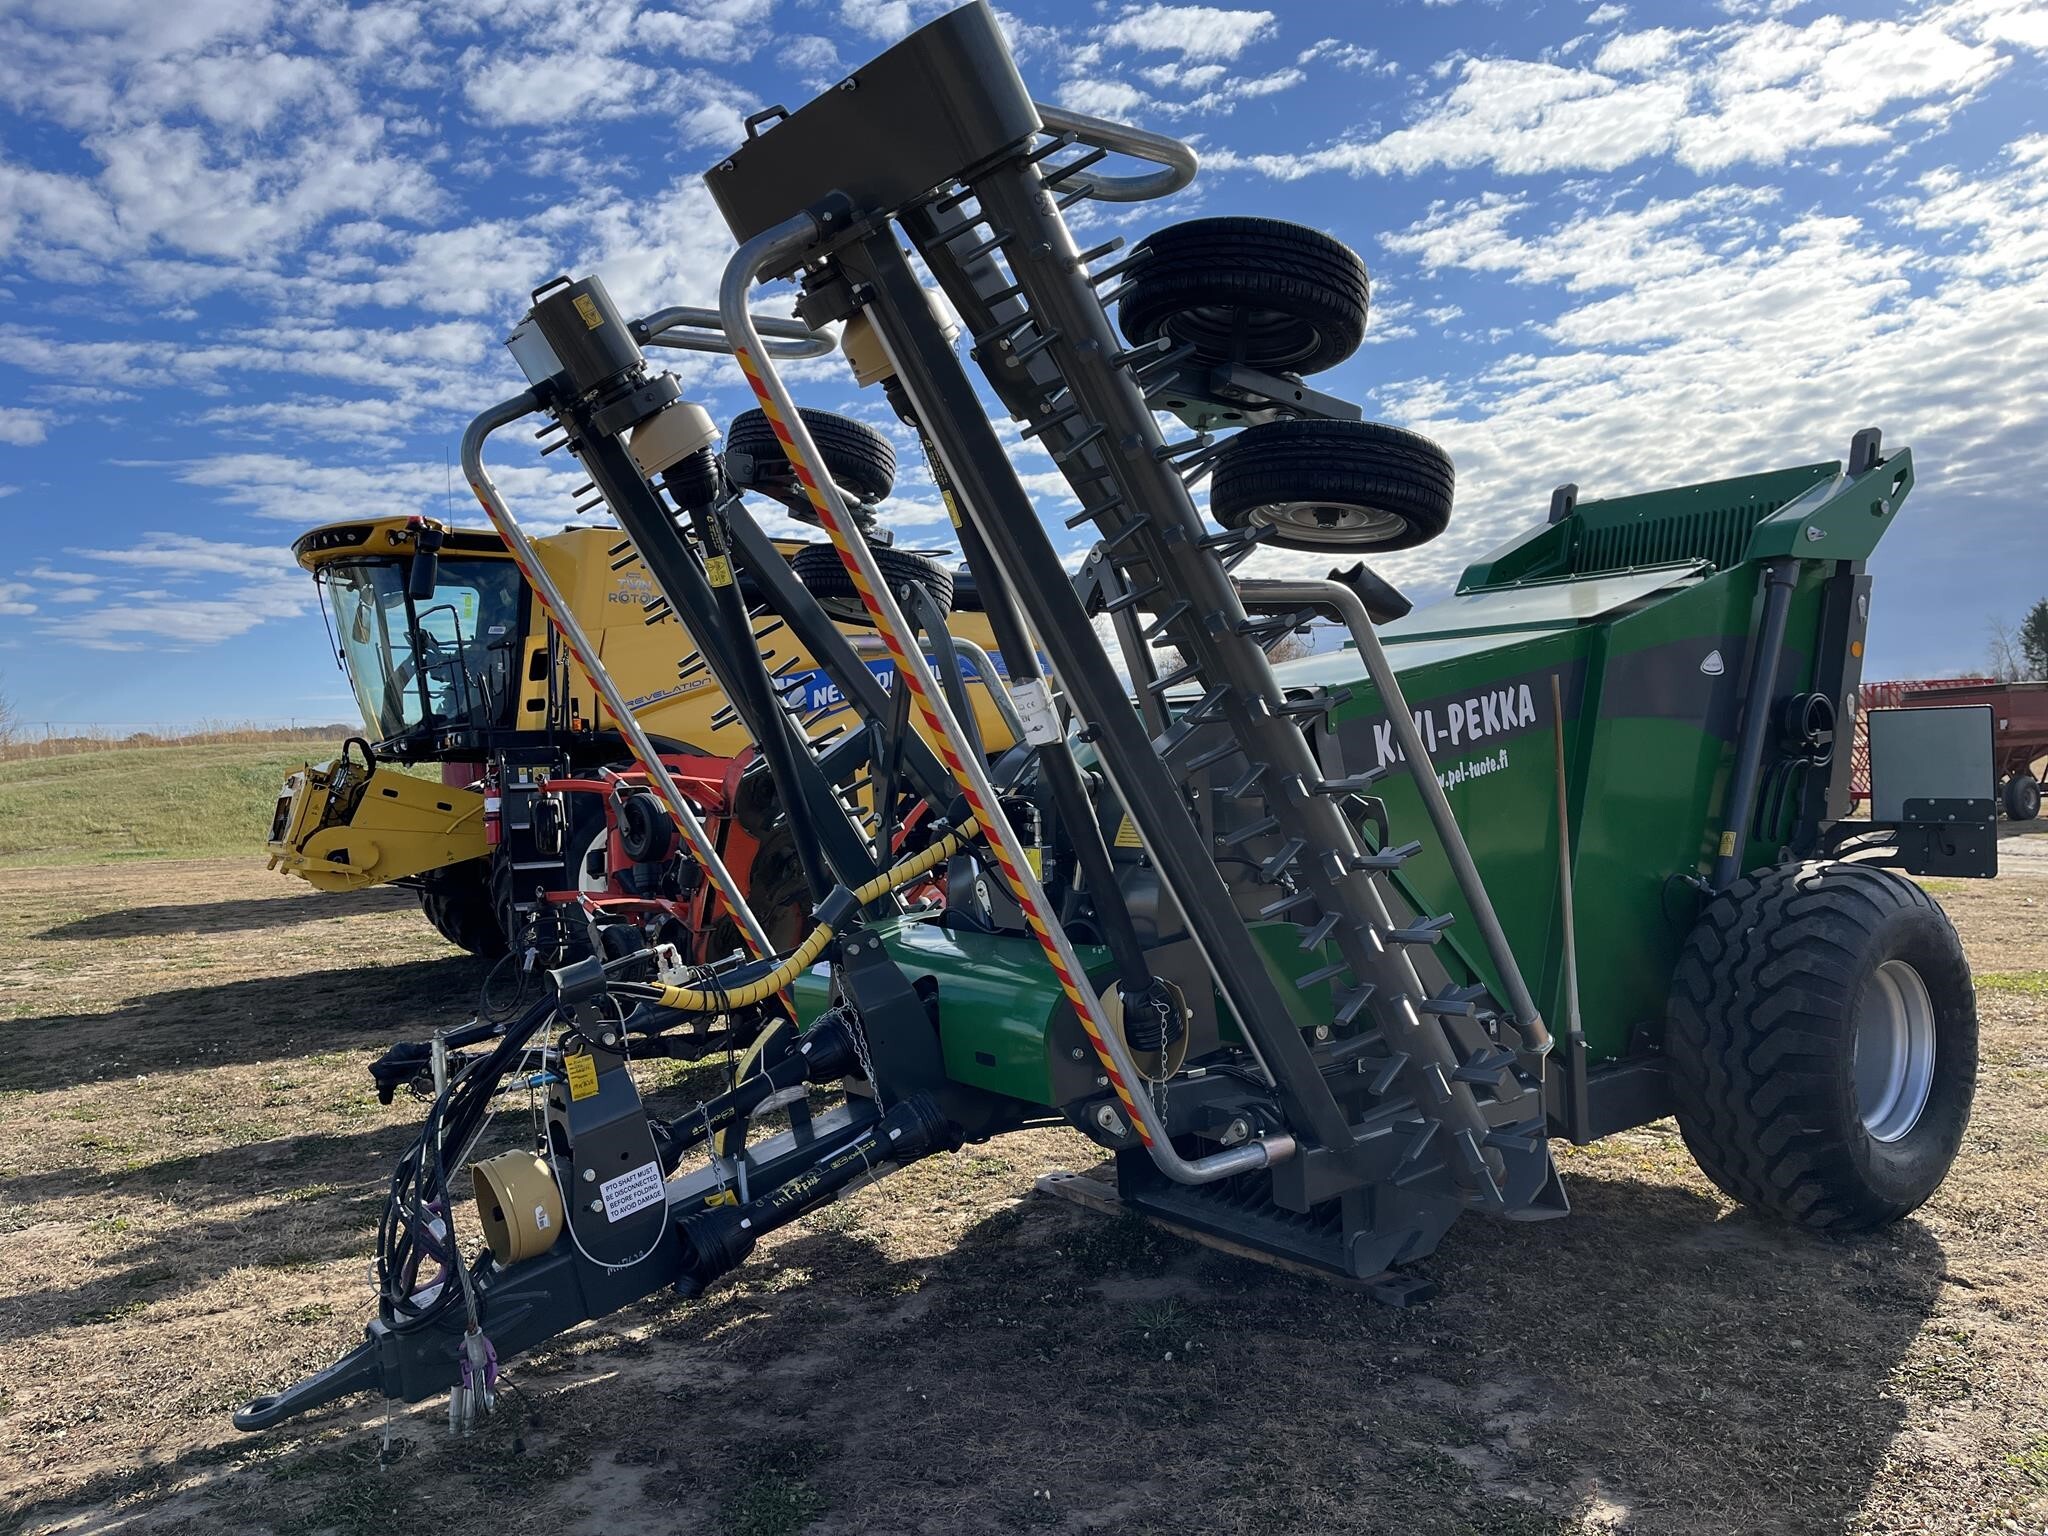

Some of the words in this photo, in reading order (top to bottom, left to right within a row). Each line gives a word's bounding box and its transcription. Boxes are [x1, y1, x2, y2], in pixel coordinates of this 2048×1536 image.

[617, 578, 652, 591] TWIN
[625, 677, 712, 707] REVELATION
[813, 688, 846, 708] NE
[1373, 684, 1536, 769] KVI-PEKKA
[605, 1183, 618, 1192] PTO
[618, 1174, 637, 1187] SHAFT
[637, 1166, 653, 1179] MUST
[605, 1192, 614, 1201] BE
[614, 1173, 658, 1198] DISCONNECTED
[609, 1195, 633, 1210] BEFORE
[633, 1182, 659, 1198] FOLDING
[610, 1209, 619, 1218] TO
[619, 1201, 637, 1215] AVOID
[637, 1190, 662, 1206] DAMAGE
